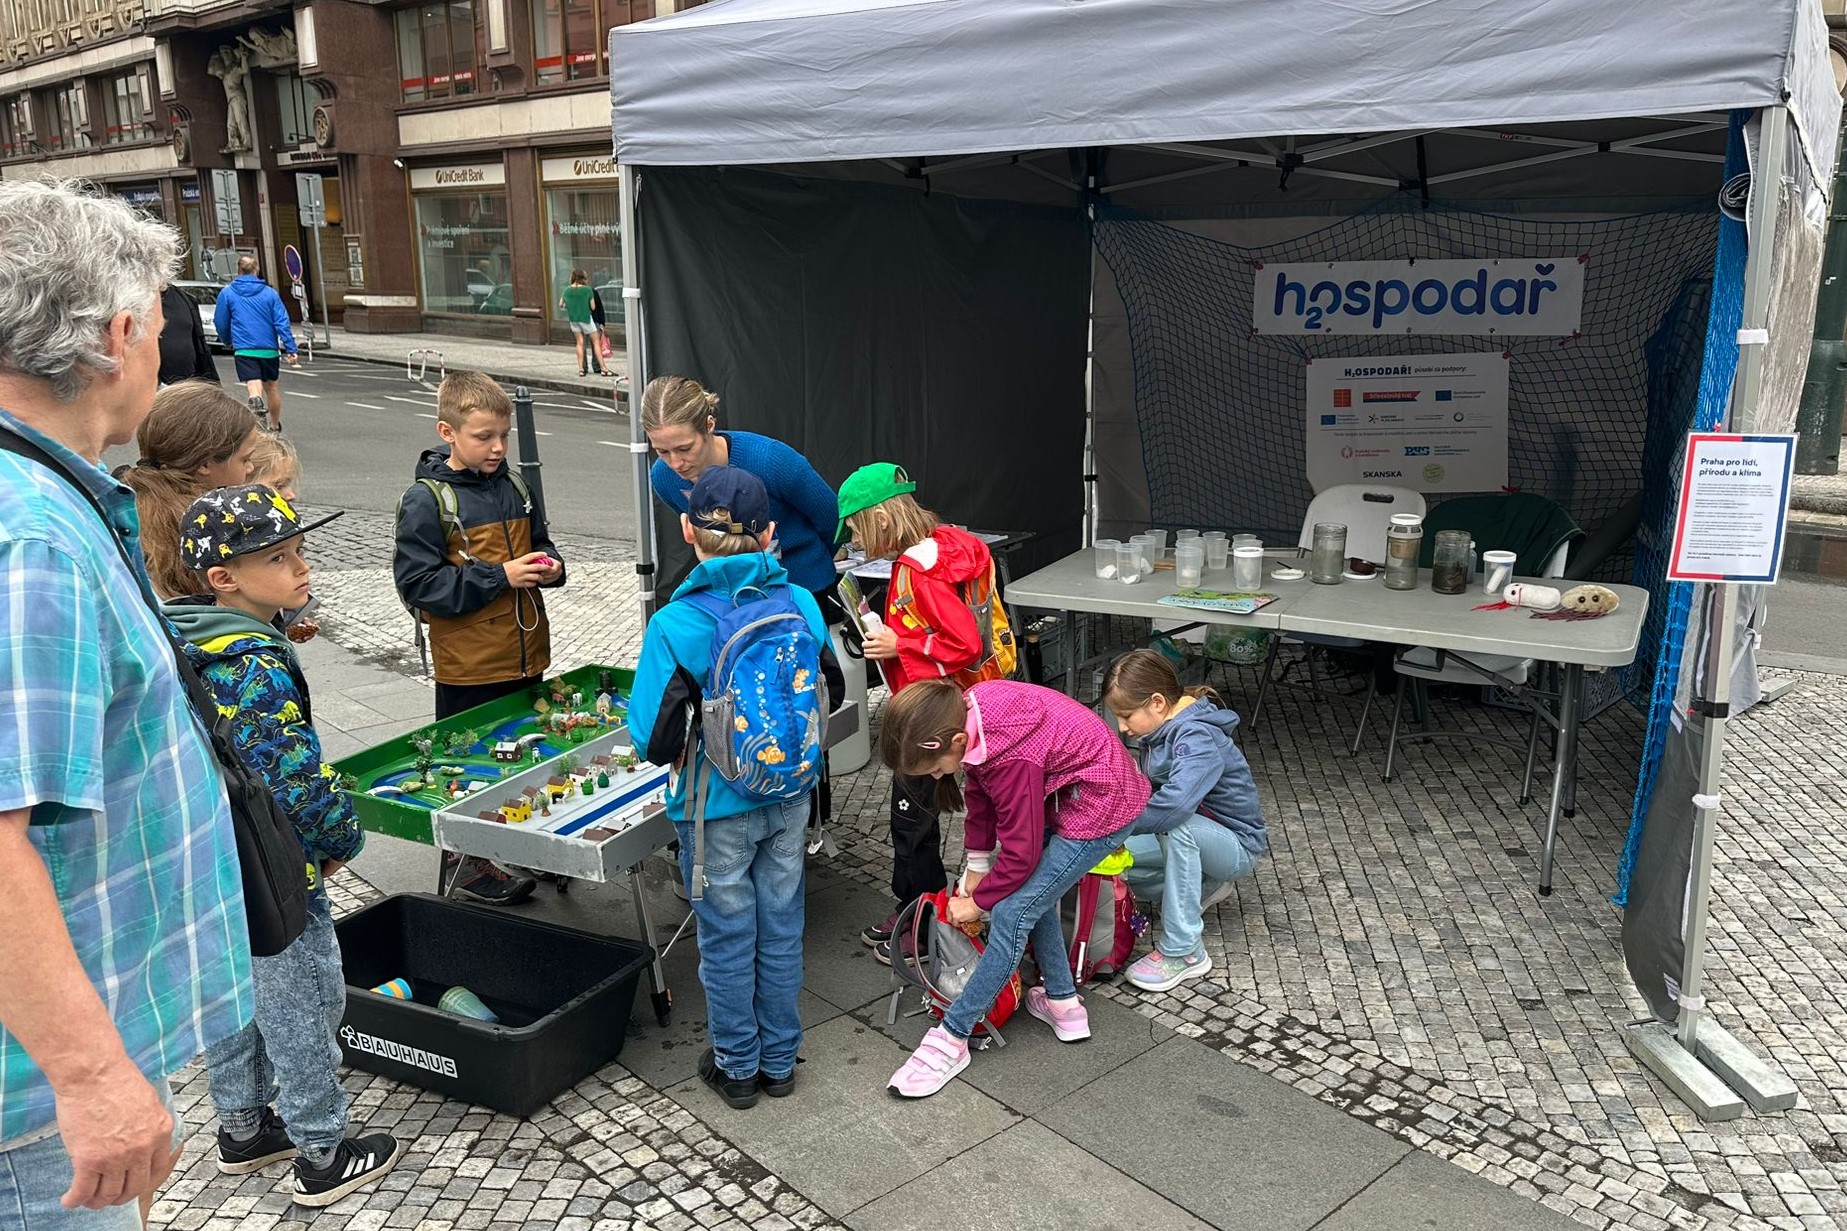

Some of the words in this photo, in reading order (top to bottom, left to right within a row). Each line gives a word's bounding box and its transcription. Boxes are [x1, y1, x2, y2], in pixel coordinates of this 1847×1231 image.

[442, 169, 468, 183] UniCredit
[469, 168, 485, 182] Bank
[1700, 457, 1725, 465] Praha
[1363, 470, 1403, 478] SKANSKA
[1699, 468, 1731, 477] přírodu
[1739, 468, 1762, 477] klima
[1229, 643, 1254, 654] 80%
[358, 1033, 458, 1077] BAUHAUS
